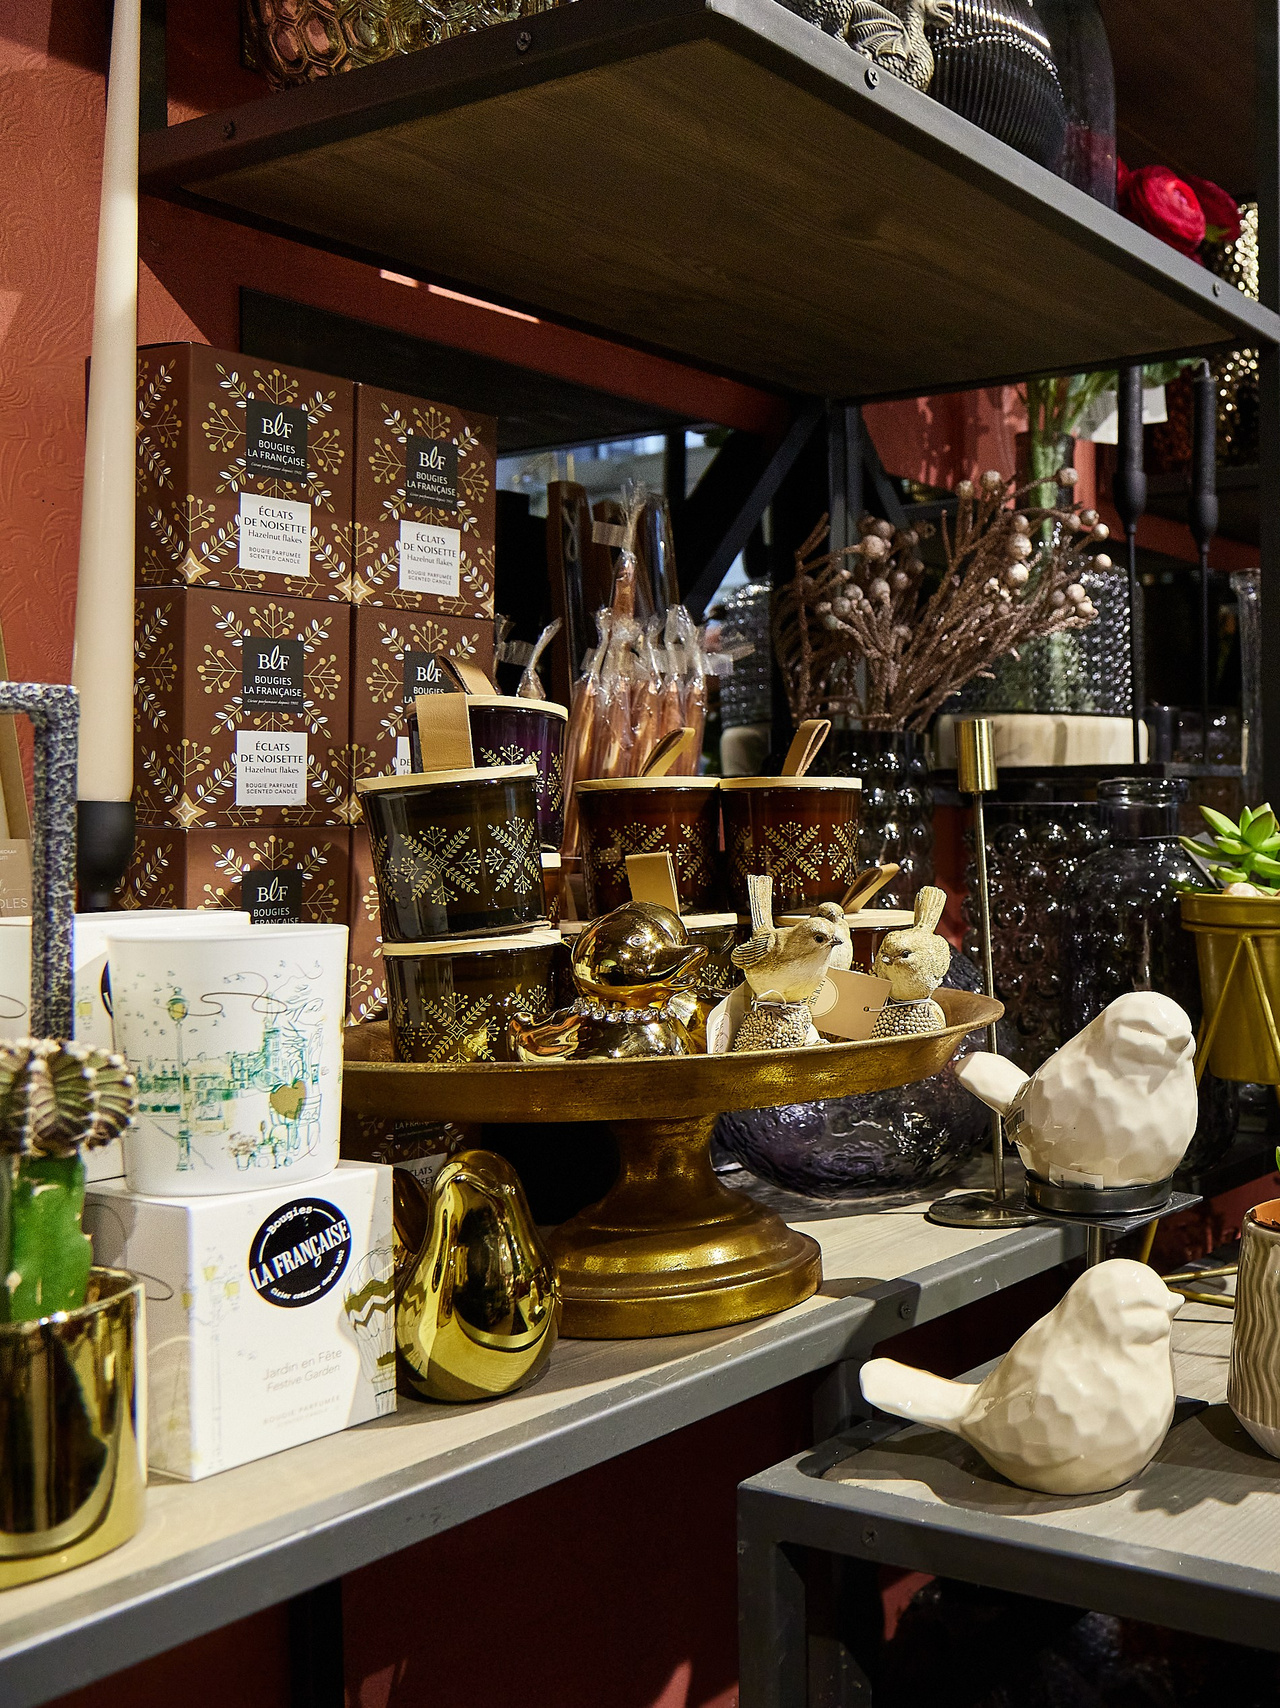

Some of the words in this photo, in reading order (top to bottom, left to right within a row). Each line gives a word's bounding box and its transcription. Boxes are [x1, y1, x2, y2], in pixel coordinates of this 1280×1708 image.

[258, 439, 296, 454] BOUGIES
[247, 448, 258, 458] LA
[260, 450, 305, 467] FRANÇAISE
[416, 471, 448, 485] BOUGIES
[406, 480, 416, 489] LA
[417, 481, 456, 497] FRANÇAISE
[259, 505, 294, 521] ÉCLATS
[244, 517, 257, 527] DE
[260, 519, 307, 535] NOISETTE
[248, 529, 281, 541] Hazelnut
[282, 534, 303, 544] flakes
[416, 531, 446, 545] ÉCLATS
[249, 546, 270, 554] BOUGIE
[403, 542, 414, 551] DE
[417, 544, 457, 558] NOISETTE
[250, 553, 276, 561] SCENTED
[277, 556, 300, 564] CANDLE
[407, 554, 435, 564] Hazelnut
[436, 558, 453, 567] flakes
[408, 575, 431, 583] SCENTED
[432, 578, 451, 586] CANDLE
[254, 675, 292, 686] BOUGIES
[243, 685, 255, 694] LA
[256, 686, 302, 698] FRANÇAISE
[404, 696, 413, 704] LA
[255, 740, 291, 752] ÉCLATS
[240, 754, 254, 763] DE
[256, 754, 304, 764] NOISETTE
[279, 766, 300, 774] flakes
[253, 907, 290, 917] BOUGIES
[411, 1166, 433, 1176] LATS
[266, 1206, 313, 1235] Bougies
[250, 1263, 276, 1290] LA
[272, 1219, 351, 1268] FRANÇAISE
[263, 1362, 298, 1381] Jardin
[301, 1358, 315, 1369] en
[318, 1349, 342, 1363] Fête
[266, 1376, 302, 1392] Festive
[304, 1364, 340, 1381] Garden
